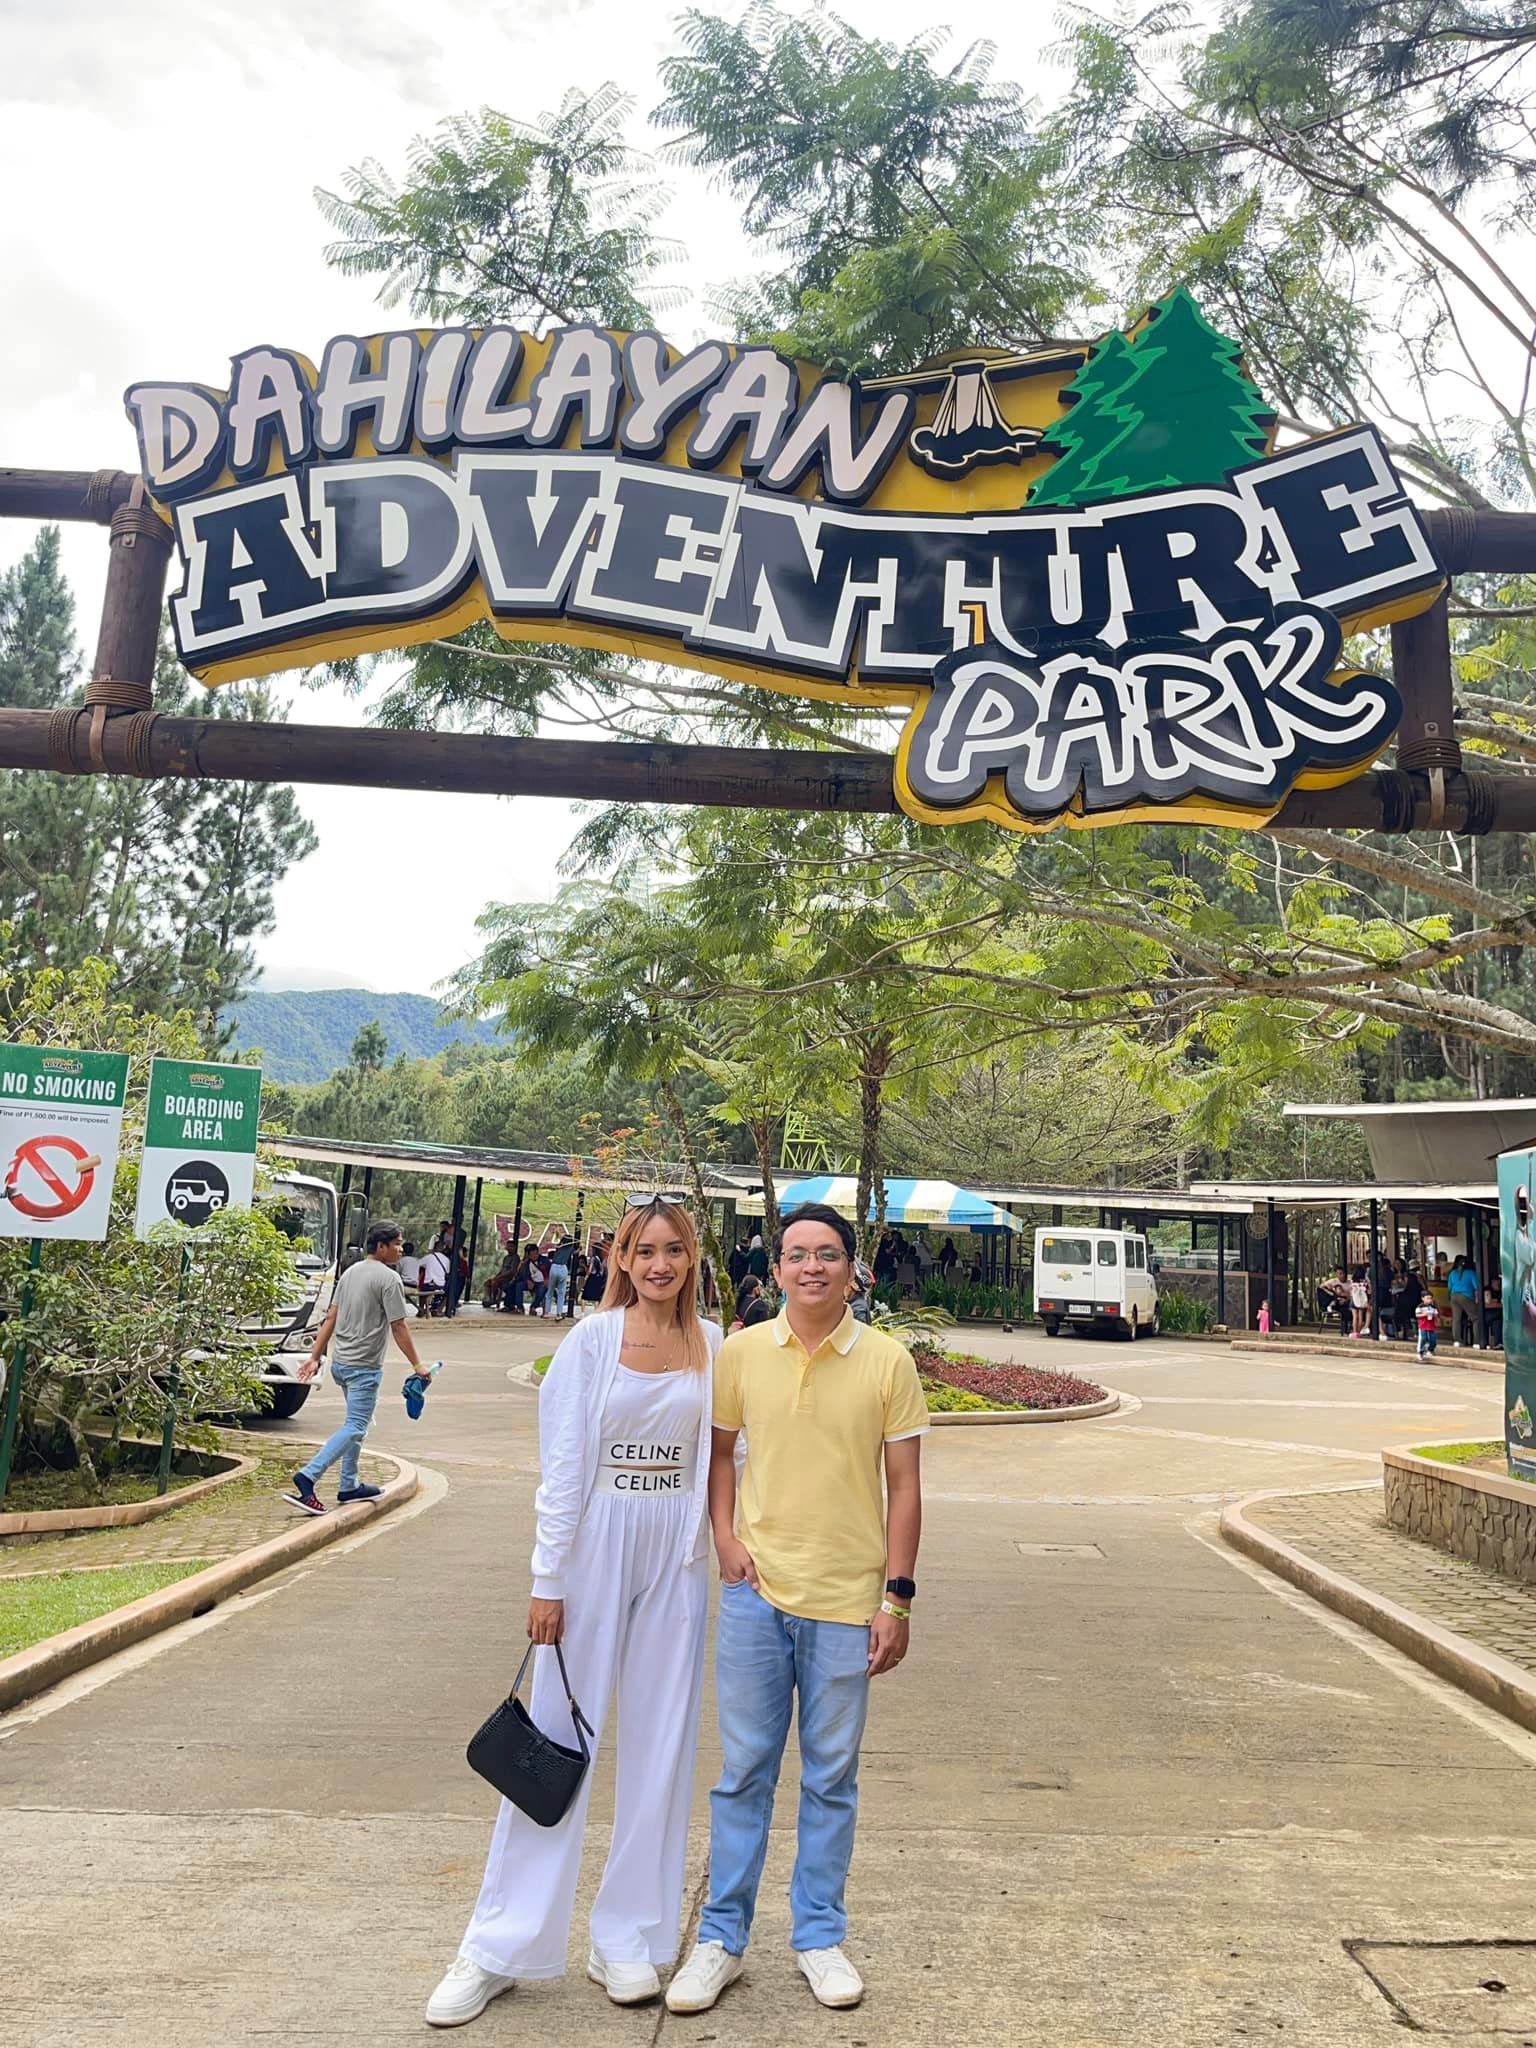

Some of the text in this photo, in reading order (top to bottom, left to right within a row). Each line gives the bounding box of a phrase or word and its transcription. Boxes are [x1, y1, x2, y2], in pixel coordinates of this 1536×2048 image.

[126, 324, 912, 500] DAHILAYAN
[174, 429, 1441, 668] ADVENTURE
[924, 615, 1386, 793] PARK
[2, 1071, 117, 1101] NO SMOKING
[164, 1095, 244, 1120] BOARDING
[182, 1119, 223, 1141] AREA
[610, 1443, 683, 1462] CELINE
[614, 1472, 682, 1492] CELINE
